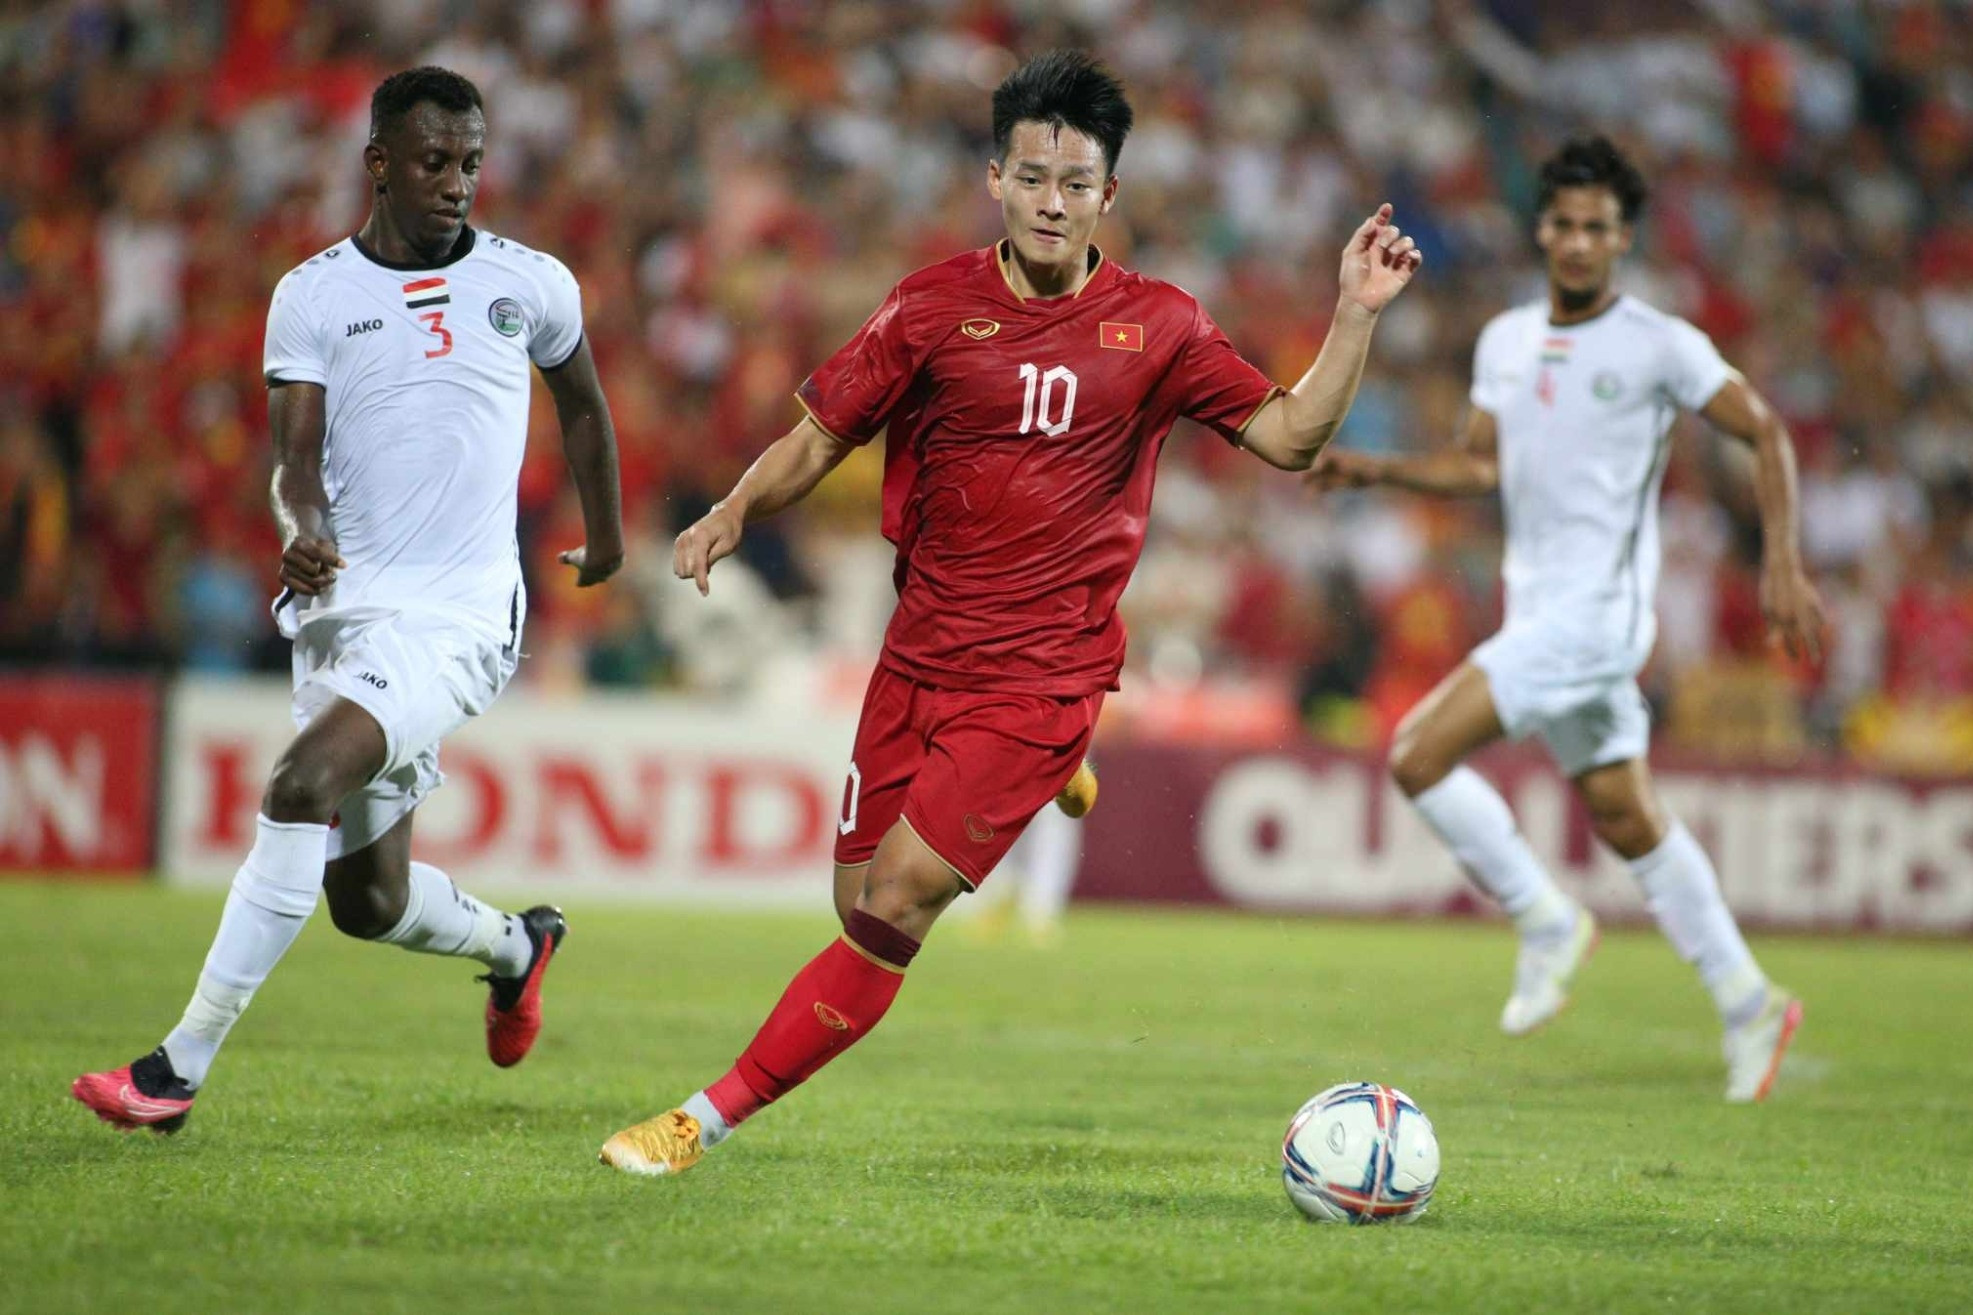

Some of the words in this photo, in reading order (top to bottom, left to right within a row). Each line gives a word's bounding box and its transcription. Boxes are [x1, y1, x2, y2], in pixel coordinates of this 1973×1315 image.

[346, 318, 383, 337] JAKO
[418, 311, 453, 359] 3
[1018, 362, 1078, 437] 10
[0, 735, 104, 860] N
[1199, 755, 1973, 920] QULIERS
